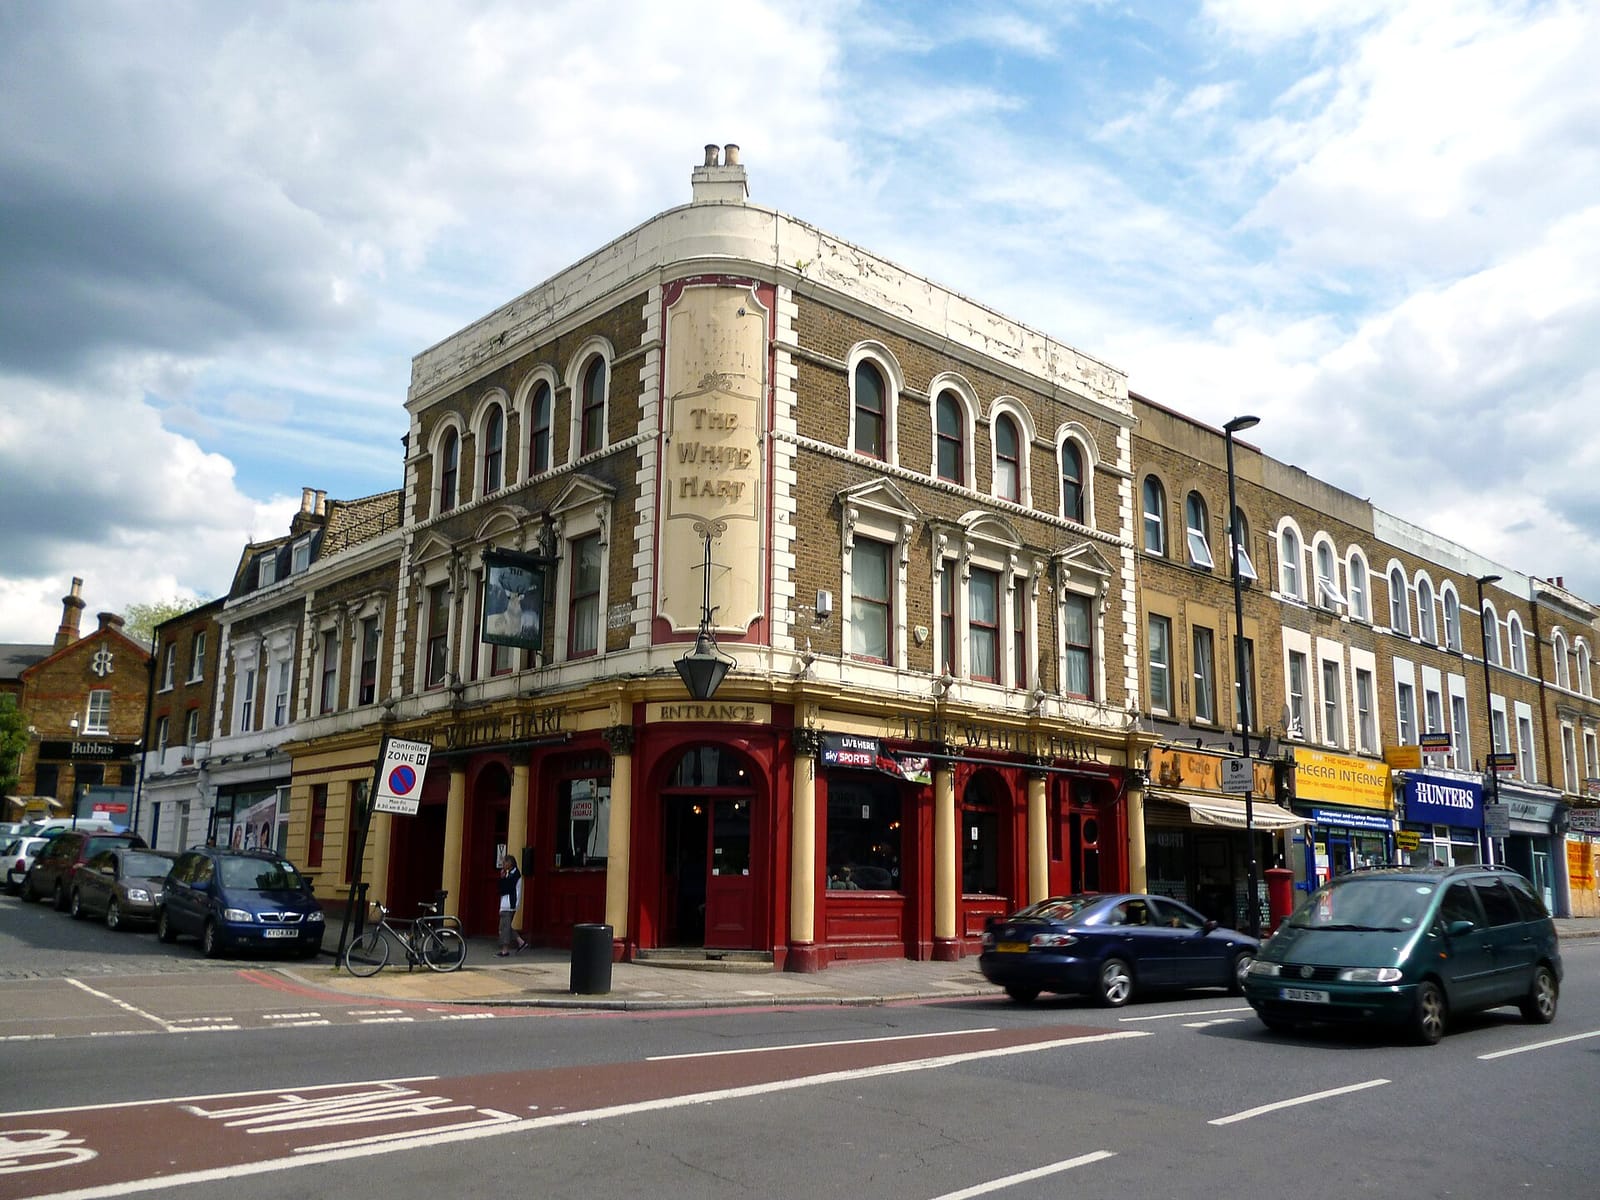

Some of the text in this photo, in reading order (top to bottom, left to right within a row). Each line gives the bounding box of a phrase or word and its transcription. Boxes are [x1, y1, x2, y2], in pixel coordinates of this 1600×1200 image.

[690, 408, 738, 429] THE
[677, 442, 752, 464] WHITE
[679, 476, 745, 497] HART
[660, 705, 755, 720] ENTRANCE
[446, 717, 501, 749] WHITE
[511, 705, 567, 738] HART
[71, 742, 114, 754] Bubbas
[391, 741, 429, 753] Controlled
[842, 738, 875, 751] LIVE HERE
[388, 751, 415, 763] ZONE
[825, 751, 870, 764] sky SPORTS
[1298, 764, 1336, 780] HEERA
[1340, 770, 1388, 788] INTERNET
[1415, 782, 1474, 810] HUNTERS
